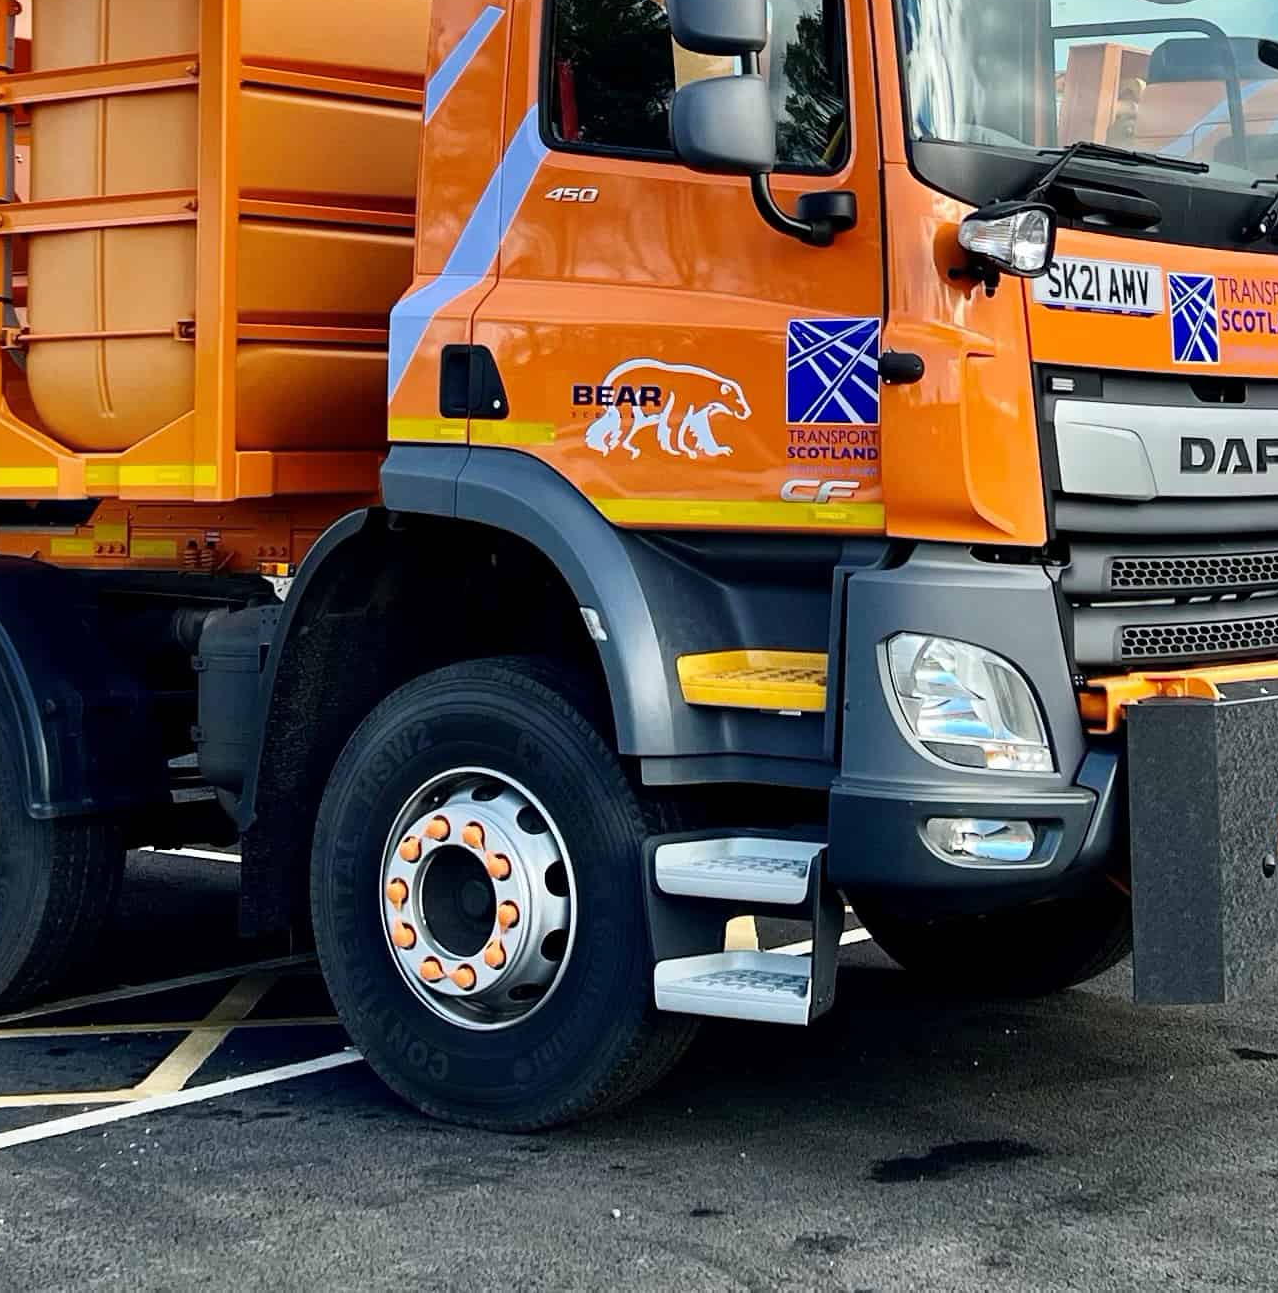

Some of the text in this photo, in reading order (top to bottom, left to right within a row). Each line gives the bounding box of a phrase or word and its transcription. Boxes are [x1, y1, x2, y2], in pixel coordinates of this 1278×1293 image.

[545, 187, 599, 203] 450
[1046, 261, 1149, 306] SK21 AMV
[573, 385, 662, 407] BEAR
[787, 430, 879, 445] TRANSPORT
[787, 447, 879, 460] SCOTLAND
[781, 480, 860, 503] CF
